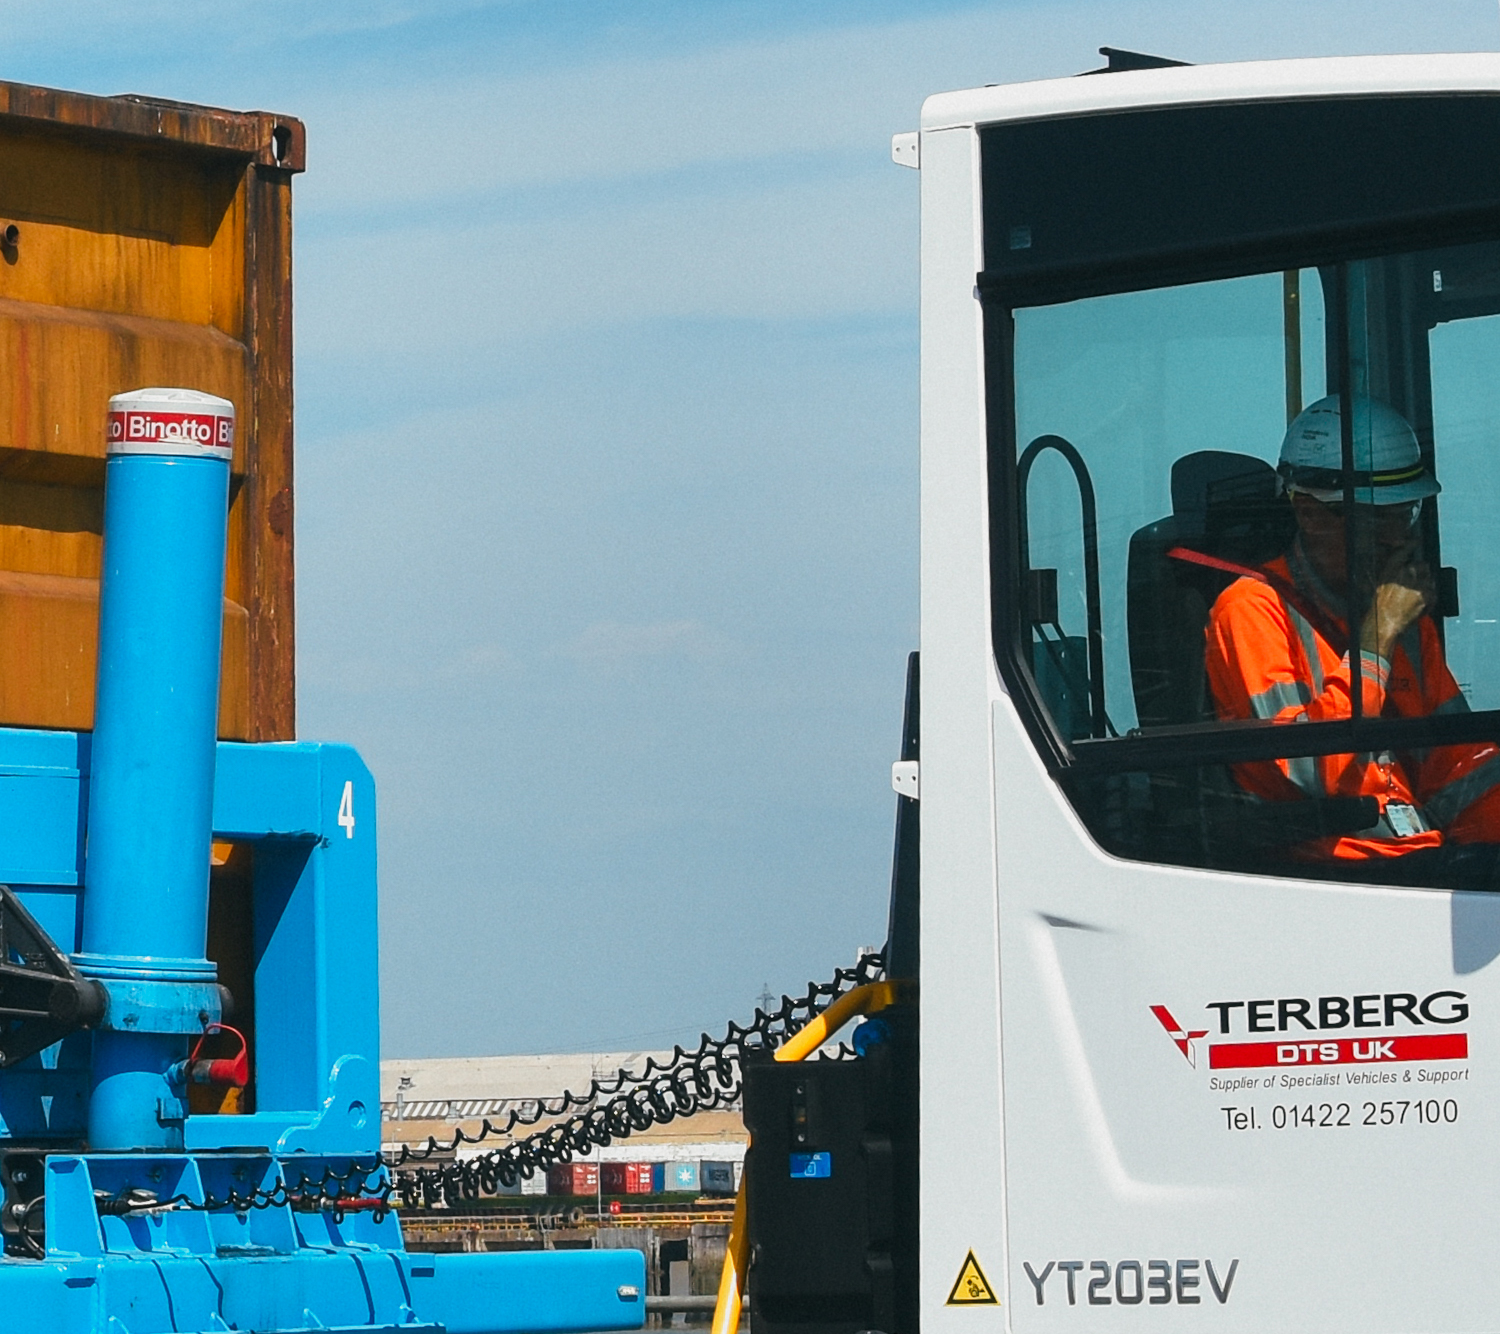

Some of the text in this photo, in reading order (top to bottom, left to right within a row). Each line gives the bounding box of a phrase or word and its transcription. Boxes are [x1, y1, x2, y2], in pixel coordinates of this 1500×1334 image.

[128, 415, 212, 441] Binotto
[336, 780, 356, 840] 4
[1205, 990, 1469, 1035] TERBERG
[1276, 1040, 1397, 1063] DTS UK
[1209, 1067, 1469, 1093] Supplier of Specialist Vehicles & Support
[1220, 1099, 1458, 1130] Tel. 01422 257100
[1022, 1259, 1239, 1306] YT203EV
